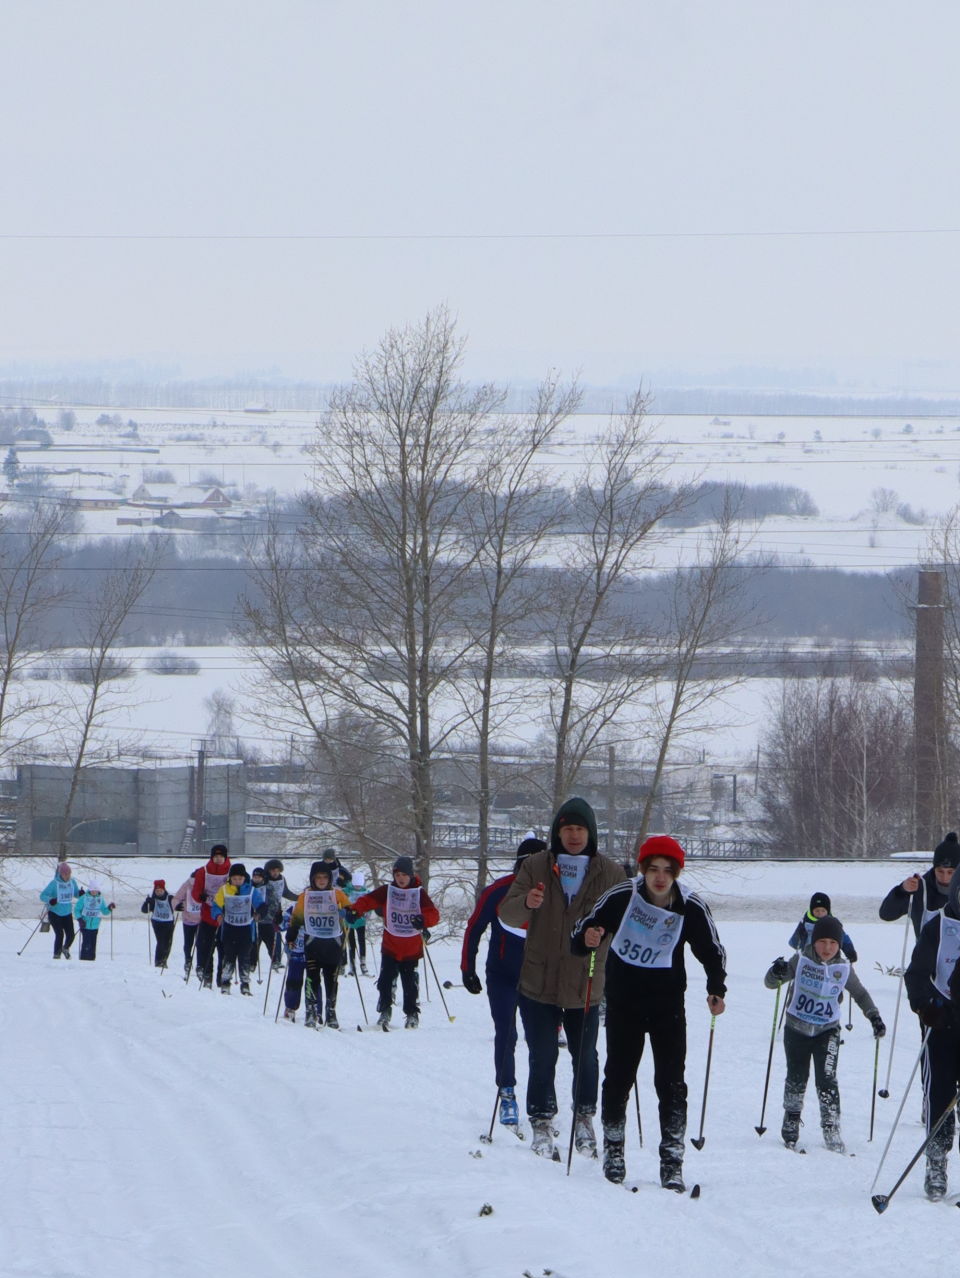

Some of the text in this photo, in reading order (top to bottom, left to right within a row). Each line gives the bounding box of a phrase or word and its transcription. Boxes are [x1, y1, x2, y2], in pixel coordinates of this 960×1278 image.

[308, 916, 335, 928] 9076
[618, 938, 662, 965] 3501
[796, 993, 834, 1019] 9024
